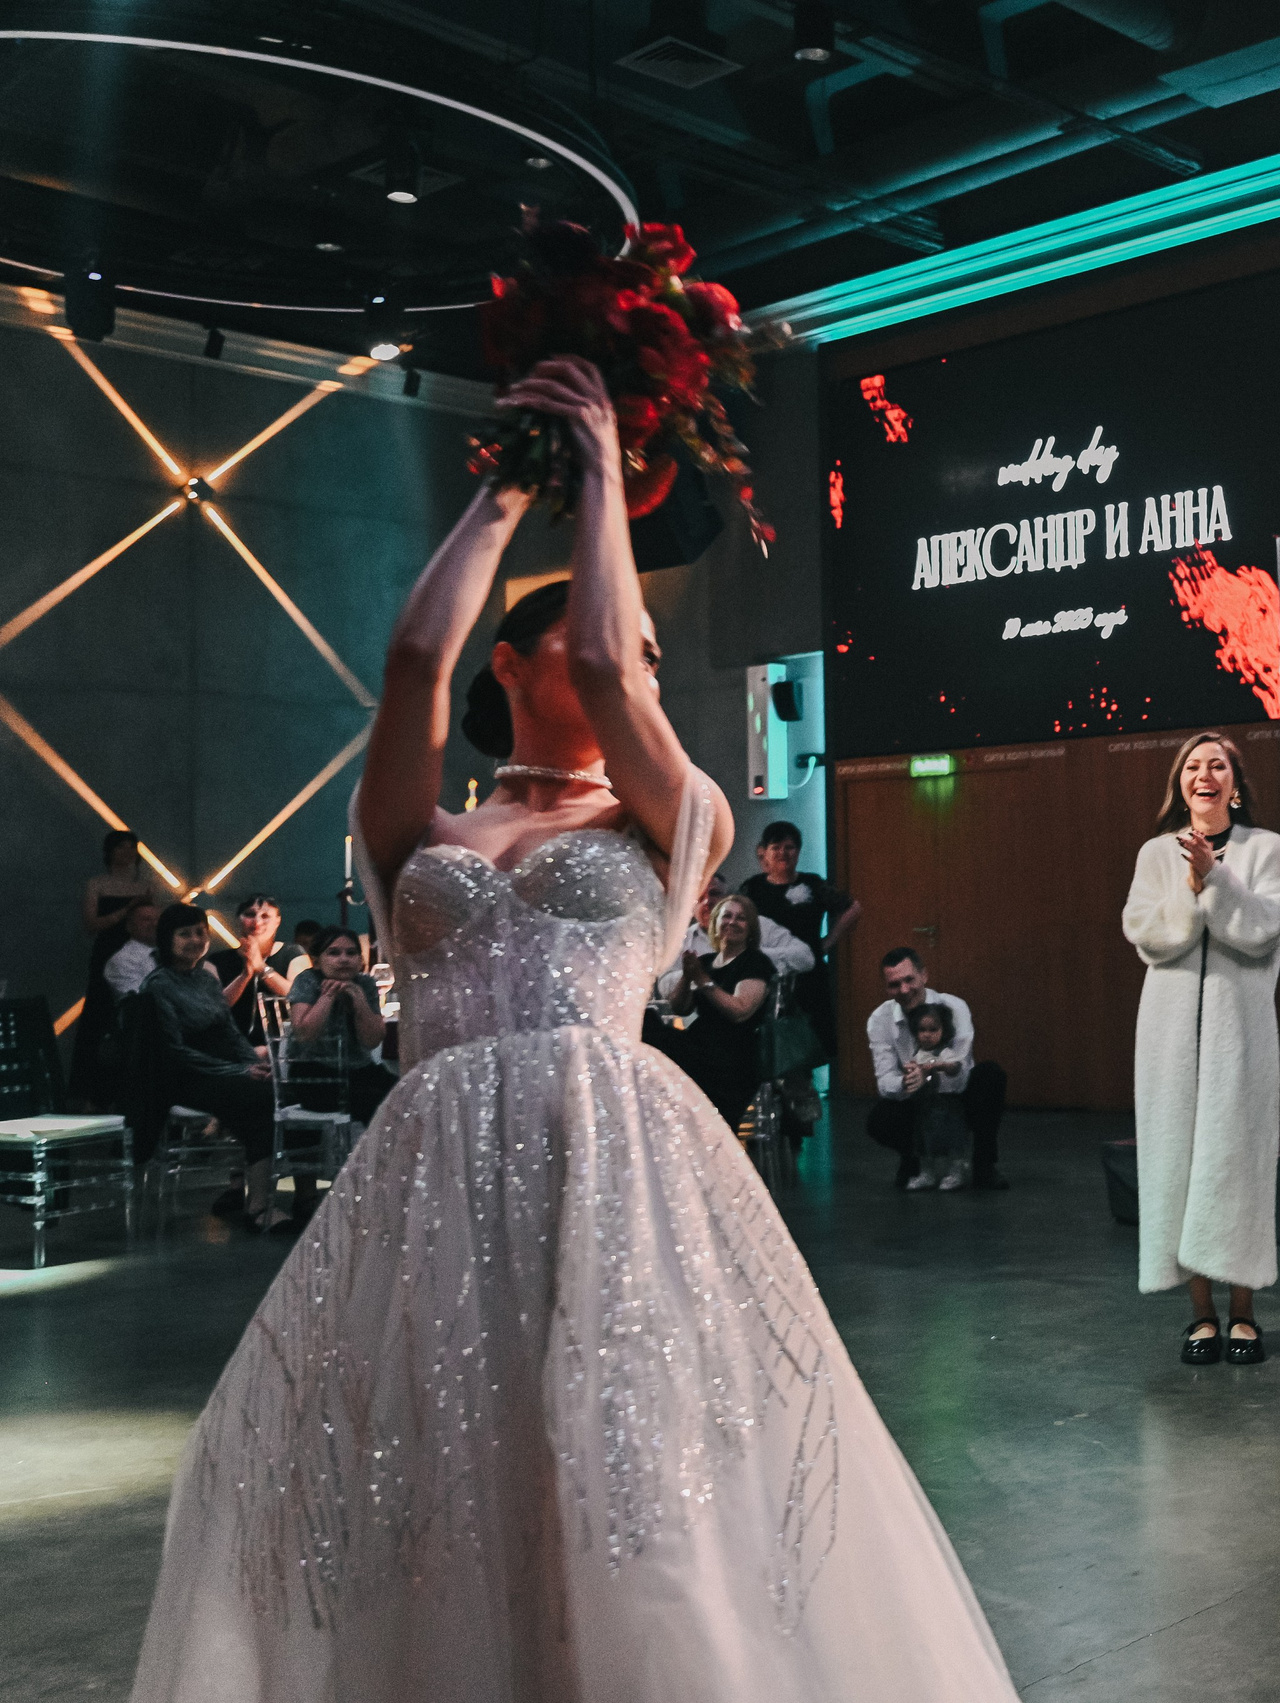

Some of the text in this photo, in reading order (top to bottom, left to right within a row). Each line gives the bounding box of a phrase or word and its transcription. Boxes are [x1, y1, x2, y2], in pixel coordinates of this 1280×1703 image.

[911, 485, 1233, 590] АЛЕКСАНДР И АННА
